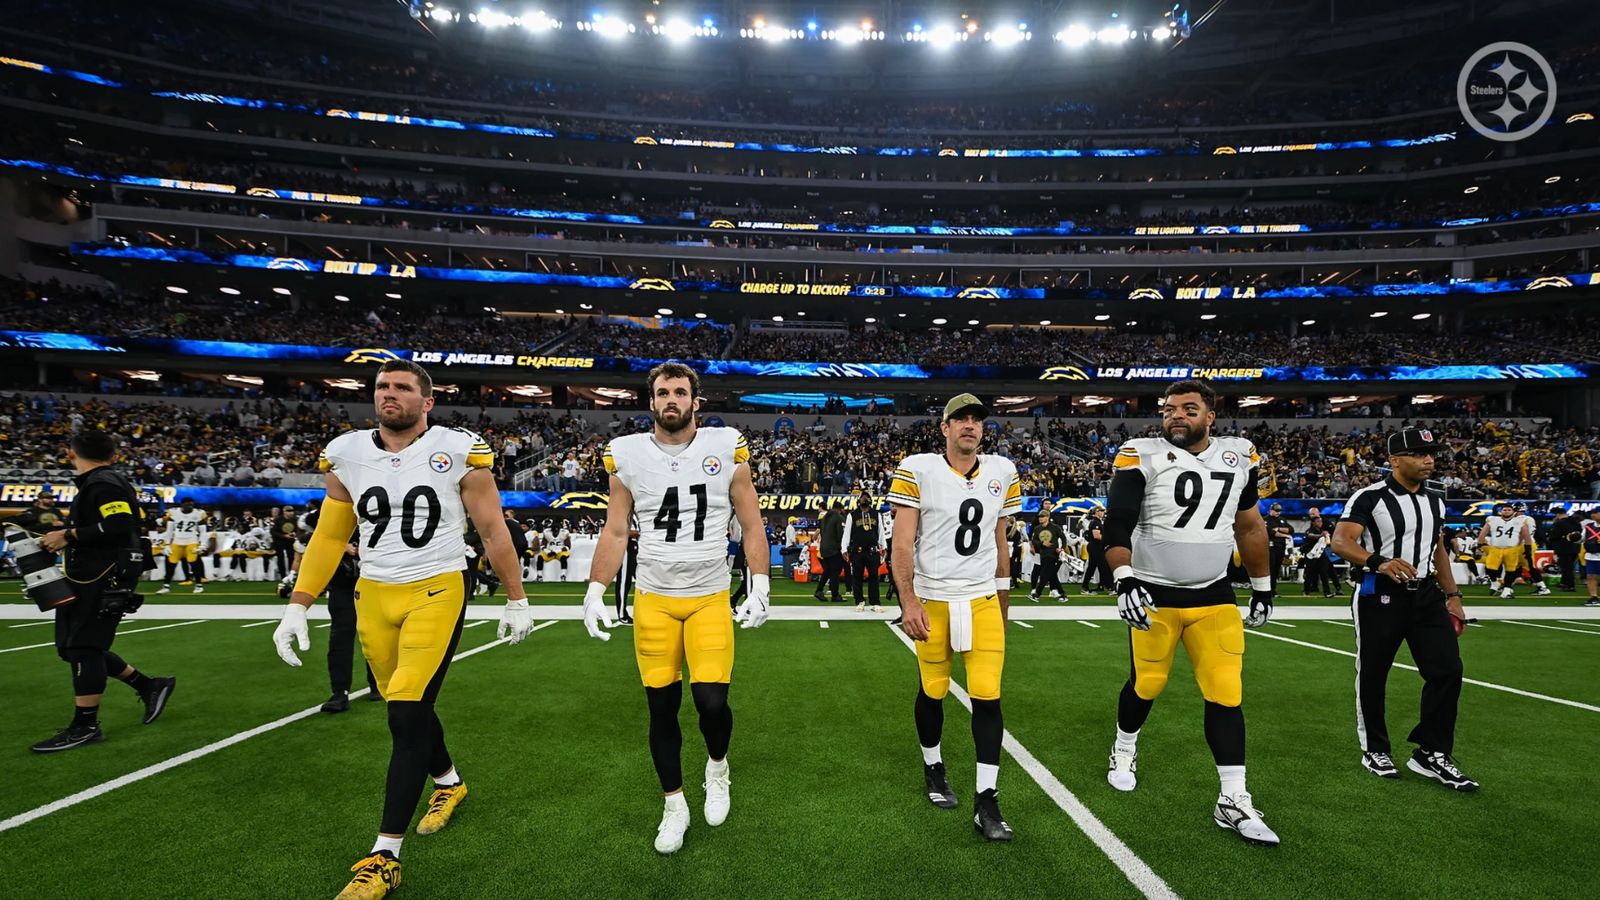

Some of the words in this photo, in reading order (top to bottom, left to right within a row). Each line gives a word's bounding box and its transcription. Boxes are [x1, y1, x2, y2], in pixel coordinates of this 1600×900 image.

[389, 264, 416, 278] LA
[740, 282, 780, 294] CHARGE
[780, 283, 795, 294] UP
[797, 284, 810, 295] TO
[810, 284, 852, 296] KICKOFF
[864, 287, 886, 296] 0:28
[1175, 287, 1205, 300] BOLT
[1204, 287, 1221, 300] UP
[1232, 287, 1256, 299] LA
[412, 352, 443, 363] LOS
[444, 352, 514, 366] ANGELES
[516, 355, 594, 369] CHARGERS
[1097, 368, 1124, 378] LOS
[1125, 368, 1189, 381] ANGELES
[1190, 367, 1264, 381] CHARGERS
[779, 495, 801, 510] UP
[1173, 471, 1235, 530] 97
[357, 485, 441, 549] 90
[653, 483, 708, 543] 41
[176, 520, 196, 532] 42
[954, 498, 984, 556] 8
[1495, 526, 1514, 539] 54
